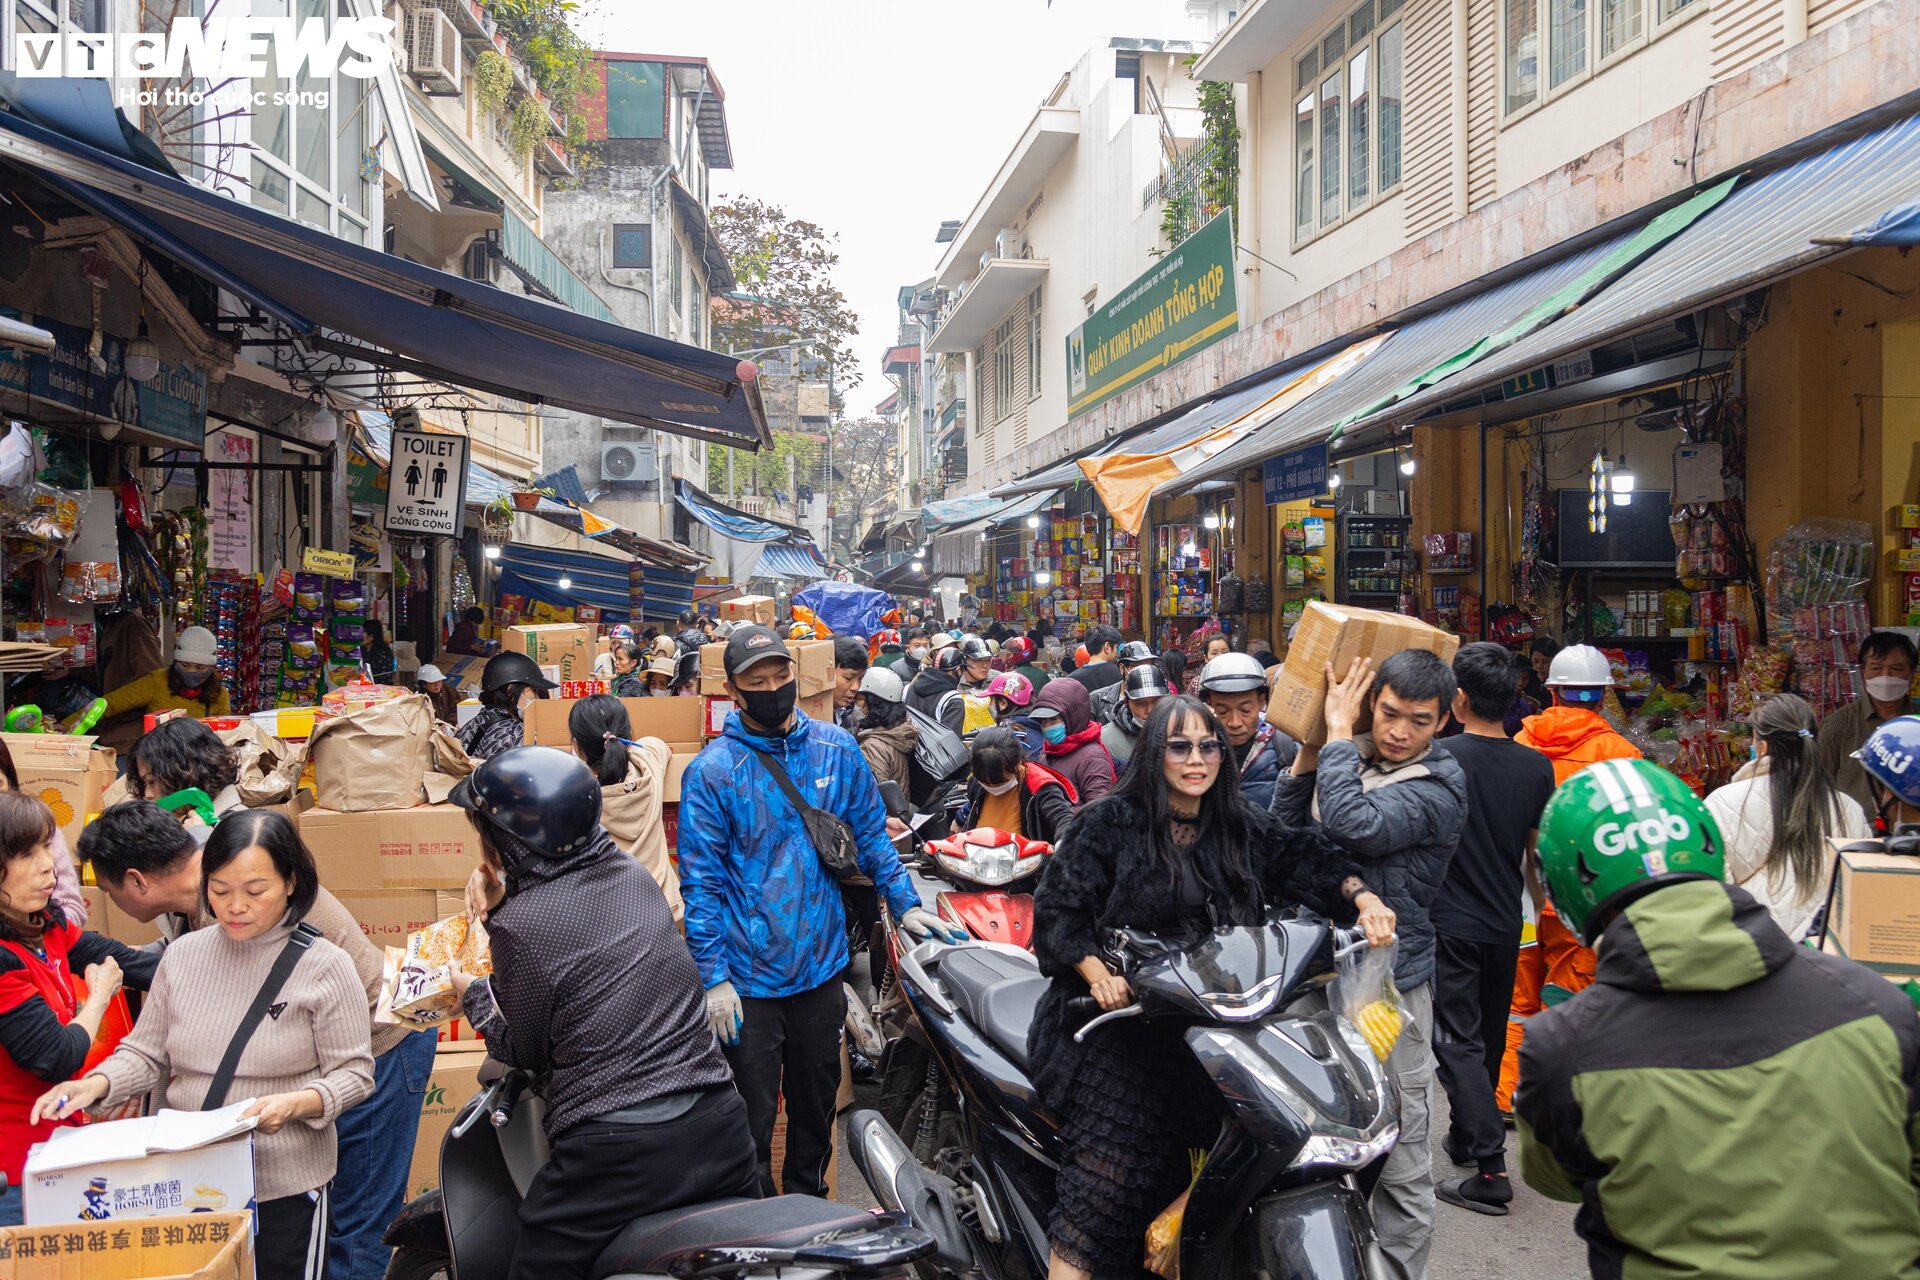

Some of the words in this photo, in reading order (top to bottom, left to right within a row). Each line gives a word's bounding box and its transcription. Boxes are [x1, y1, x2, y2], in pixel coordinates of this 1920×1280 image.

[1087, 336, 1108, 377] QUẦY
[1109, 327, 1132, 364] KINH
[1131, 305, 1165, 350] DOANH
[1165, 278, 1197, 327] TỔNG
[1198, 263, 1224, 310] HỢP
[403, 437, 455, 457] TOILET
[397, 505, 414, 516] VỆ
[418, 507, 448, 518] SINH
[390, 516, 420, 527] CÔNG
[422, 519, 452, 530] CỘNG
[312, 555, 341, 567] ORION
[1592, 808, 1690, 857] Grab
[420, 1108, 439, 1116] uxury
[440, 1106, 456, 1114] Food
[113, 1179, 182, 1202] 豪士乳酸菌
[114, 1197, 153, 1211] HORSH
[155, 1193, 183, 1209] 面包
[140, 1221, 230, 1248] 绽放味蕾
